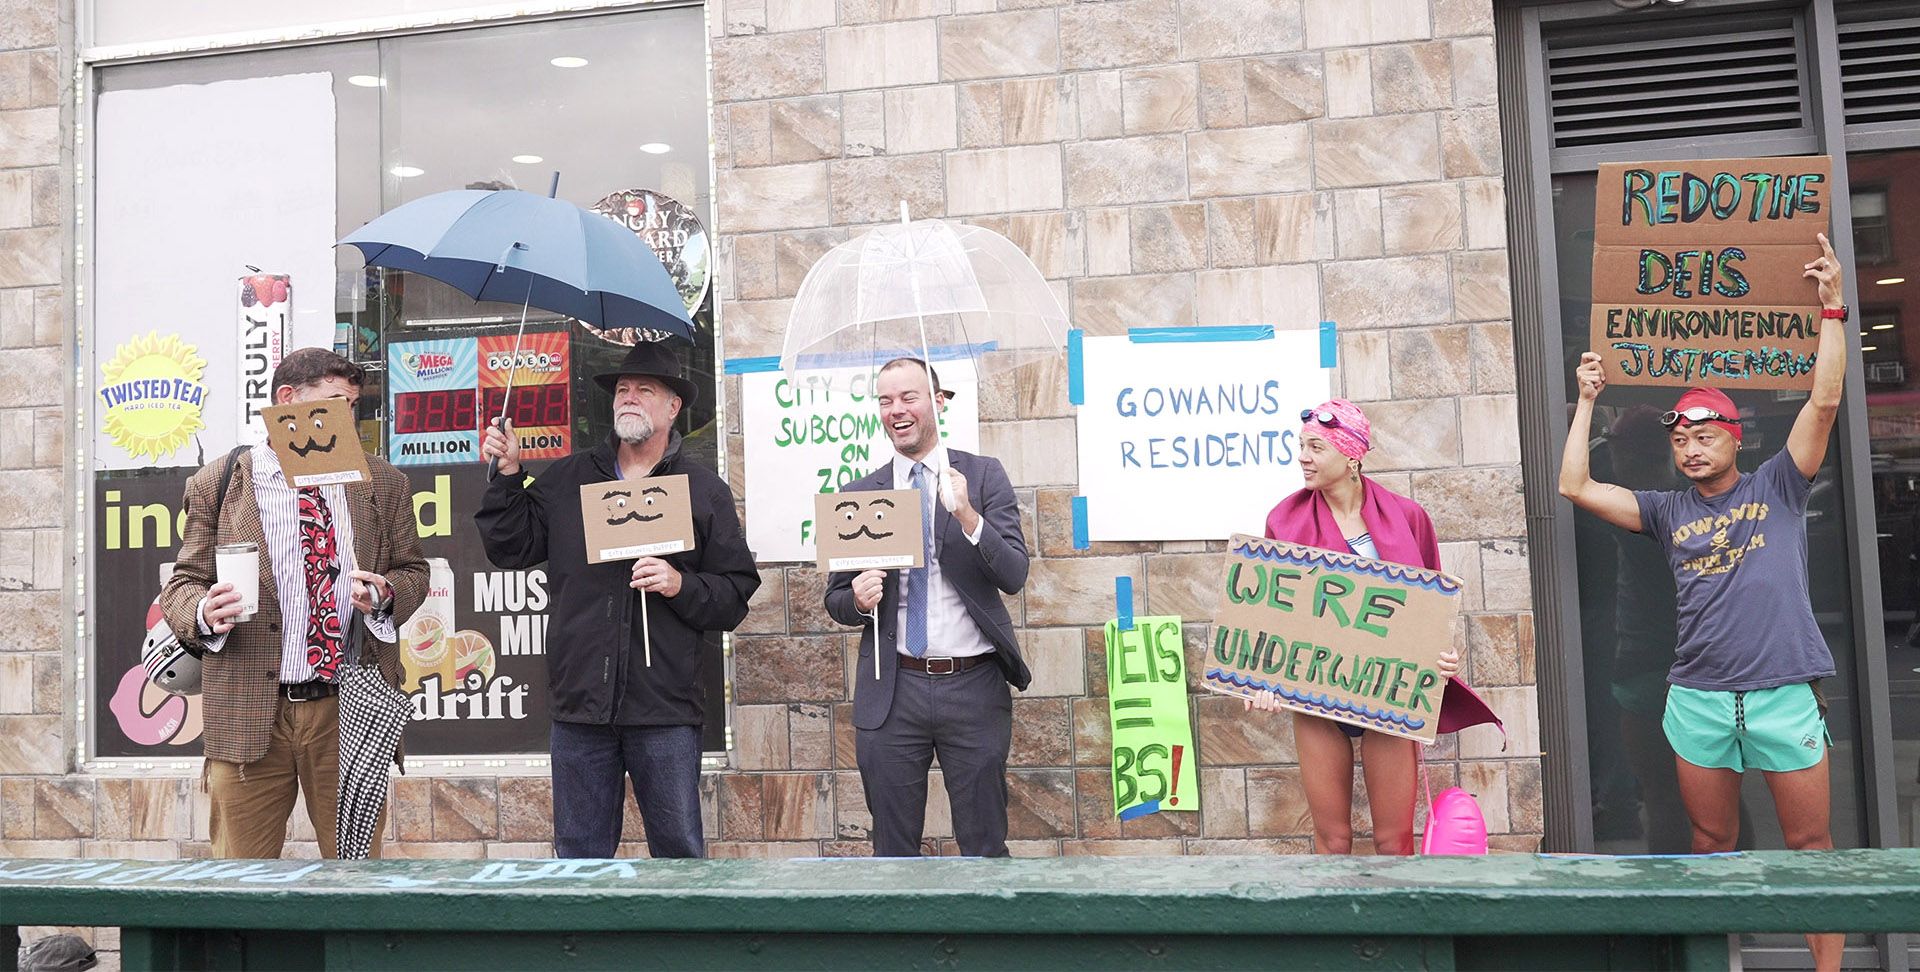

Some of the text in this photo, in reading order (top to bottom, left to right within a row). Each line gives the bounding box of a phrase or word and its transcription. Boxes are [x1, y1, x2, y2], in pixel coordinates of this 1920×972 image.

[602, 210, 671, 231] NGRY
[1635, 246, 1750, 299] DEIS
[1606, 306, 1819, 341] ENVIRONMENTAL
[246, 315, 267, 424] TRULY
[418, 354, 453, 369] MEGA
[101, 378, 203, 408] TWISTED TEA
[775, 375, 832, 408] CITY
[1116, 380, 1280, 417] GOWANUS
[401, 440, 471, 456] MILLION
[841, 443, 869, 464] ON
[1120, 430, 1294, 468] RESIDENTS
[474, 569, 550, 613] MUS
[1226, 562, 1407, 638] WE'RE
[1213, 625, 1438, 713] UNDERWATER
